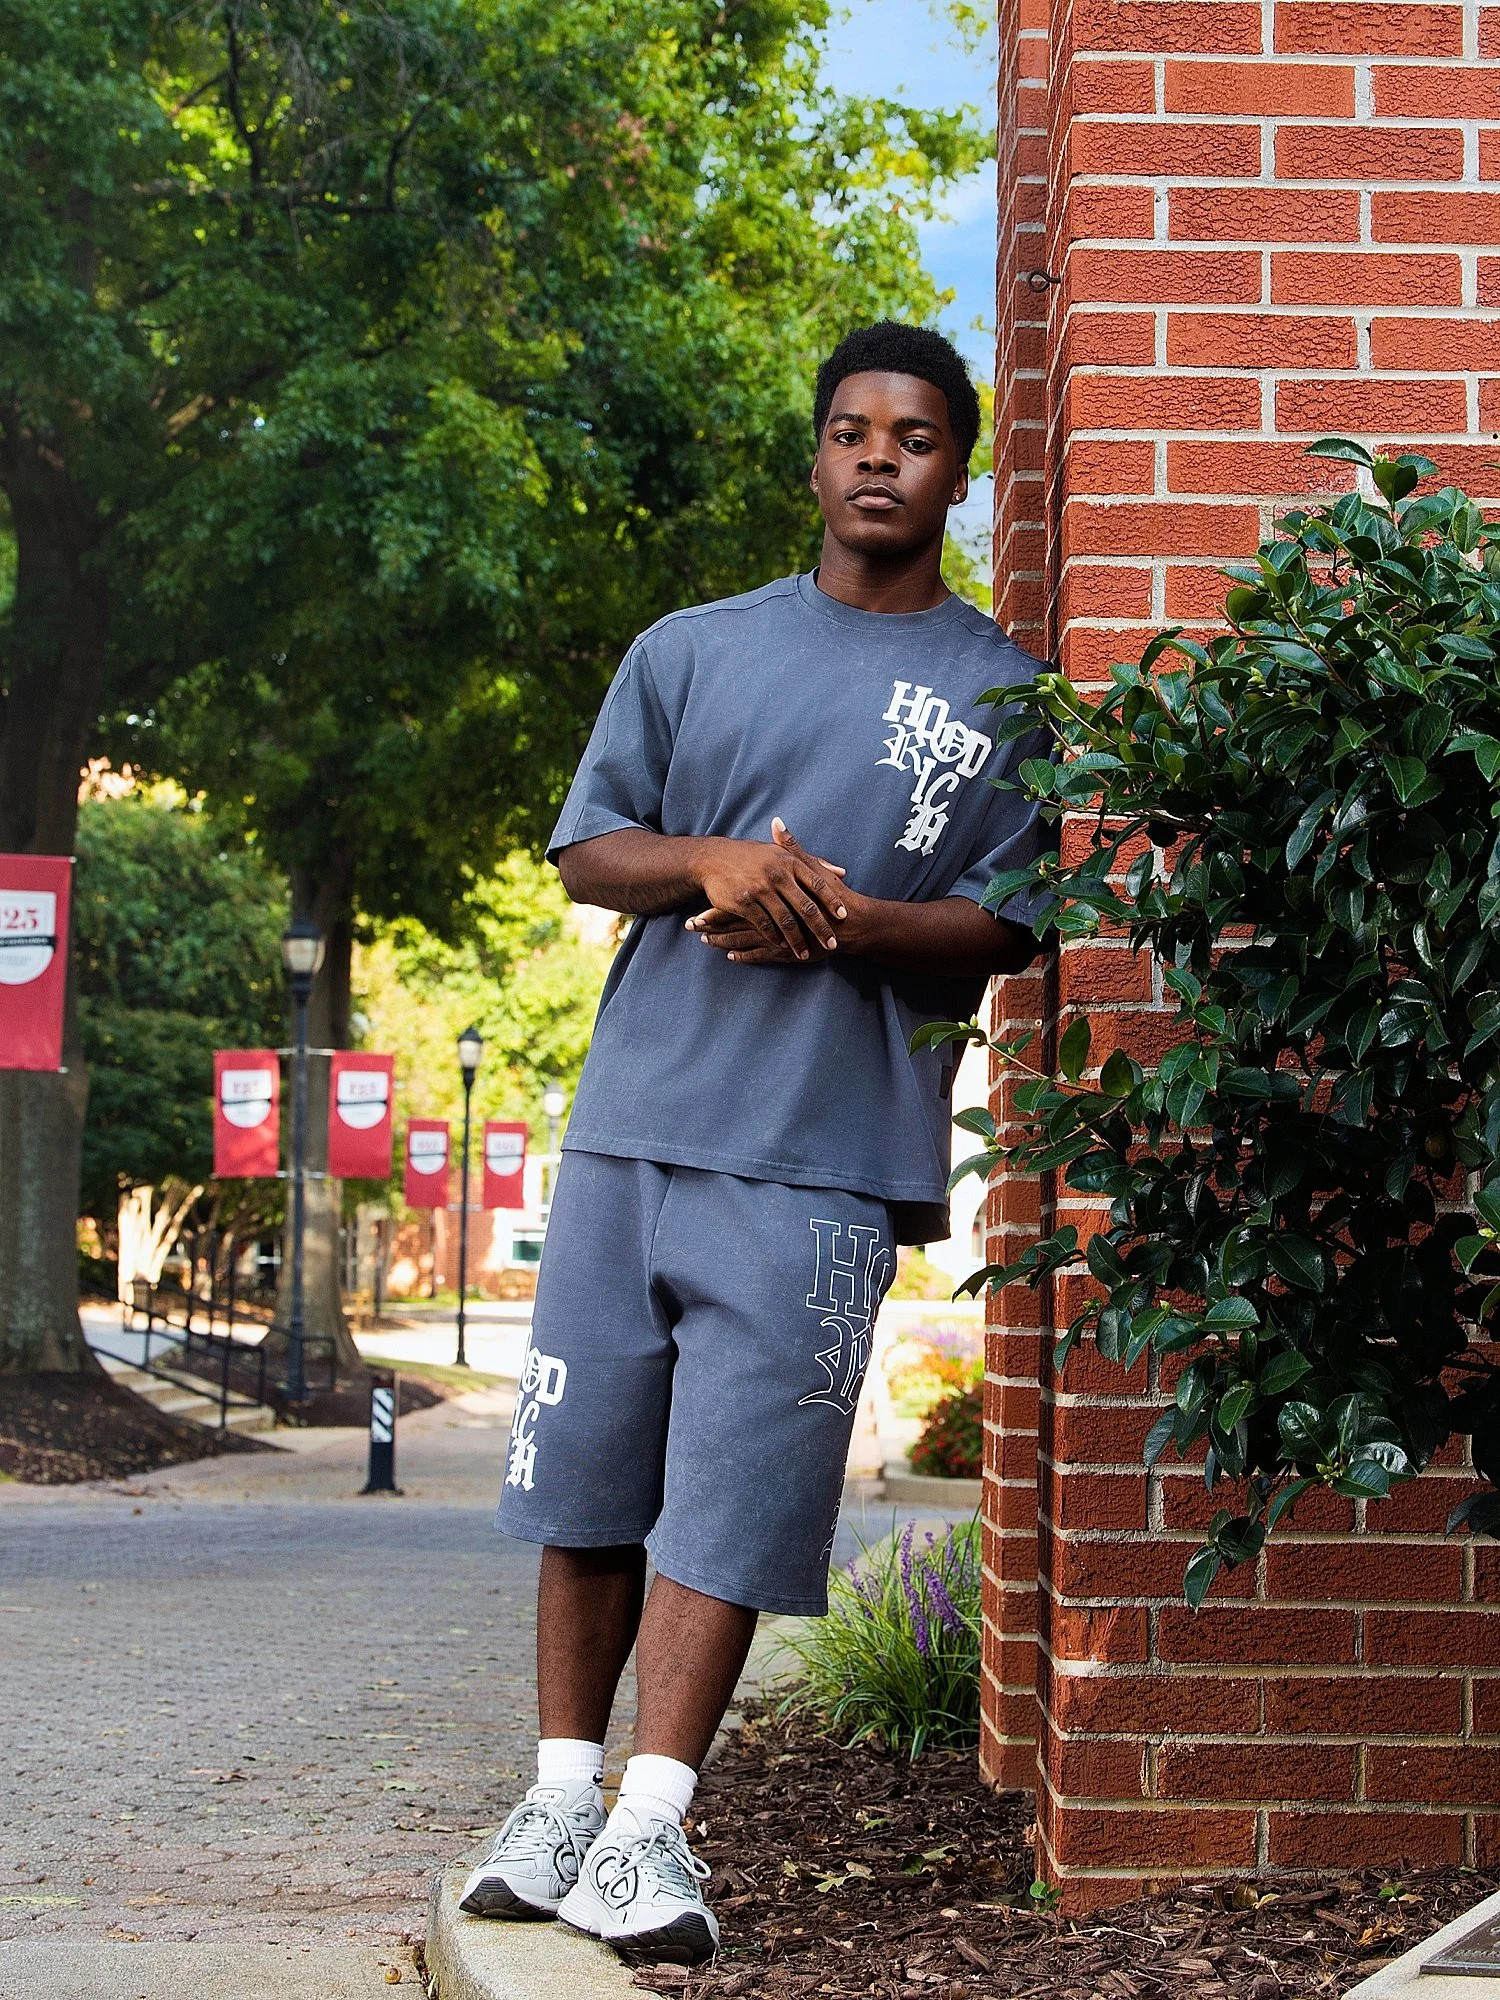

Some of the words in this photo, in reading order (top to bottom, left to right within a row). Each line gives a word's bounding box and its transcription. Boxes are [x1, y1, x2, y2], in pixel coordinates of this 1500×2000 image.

[882, 680, 992, 779] HOOD
[874, 723, 960, 857] RICH
[0, 908, 38, 929] 25
